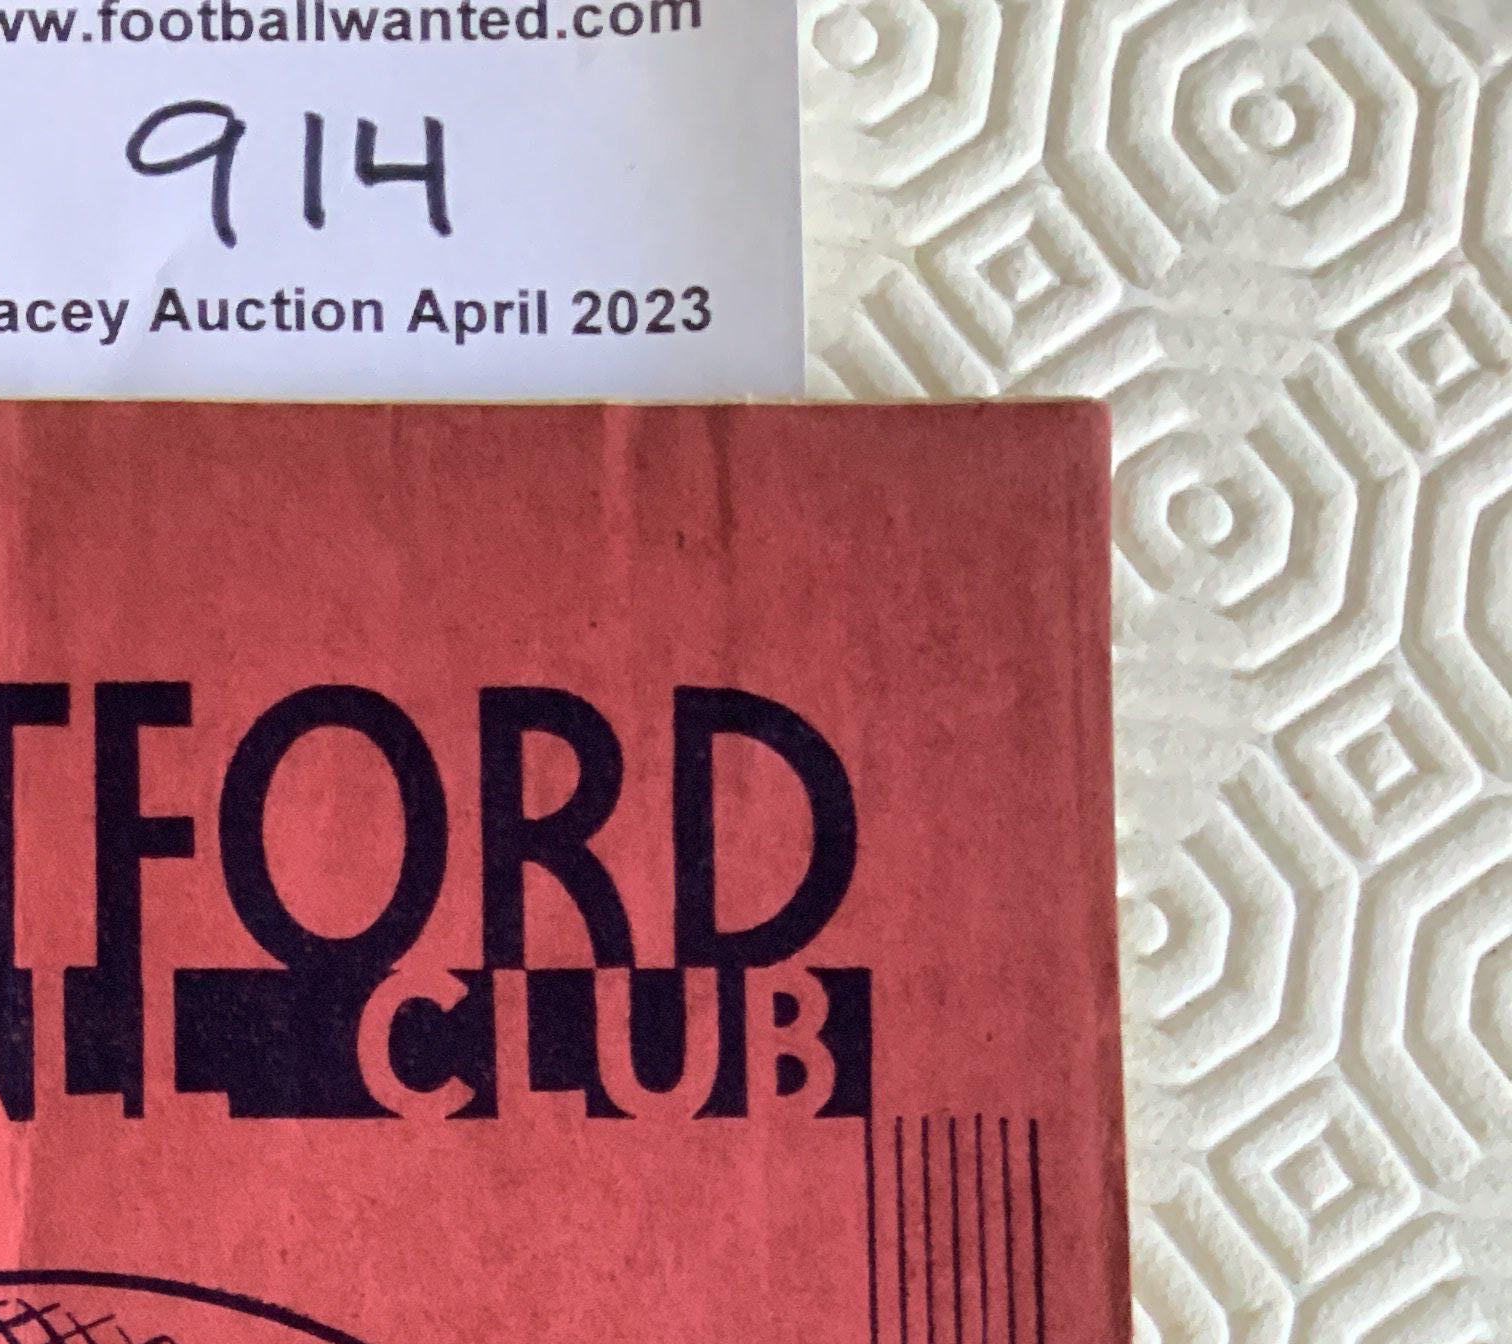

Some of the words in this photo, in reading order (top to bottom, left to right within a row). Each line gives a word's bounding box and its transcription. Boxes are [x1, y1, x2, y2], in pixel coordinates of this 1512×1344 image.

[125, 99, 453, 249] 914
[149, 288, 384, 334] Auction
[407, 286, 550, 346] April
[571, 285, 713, 334] 2023
[352, 968, 838, 1120] CLUB
